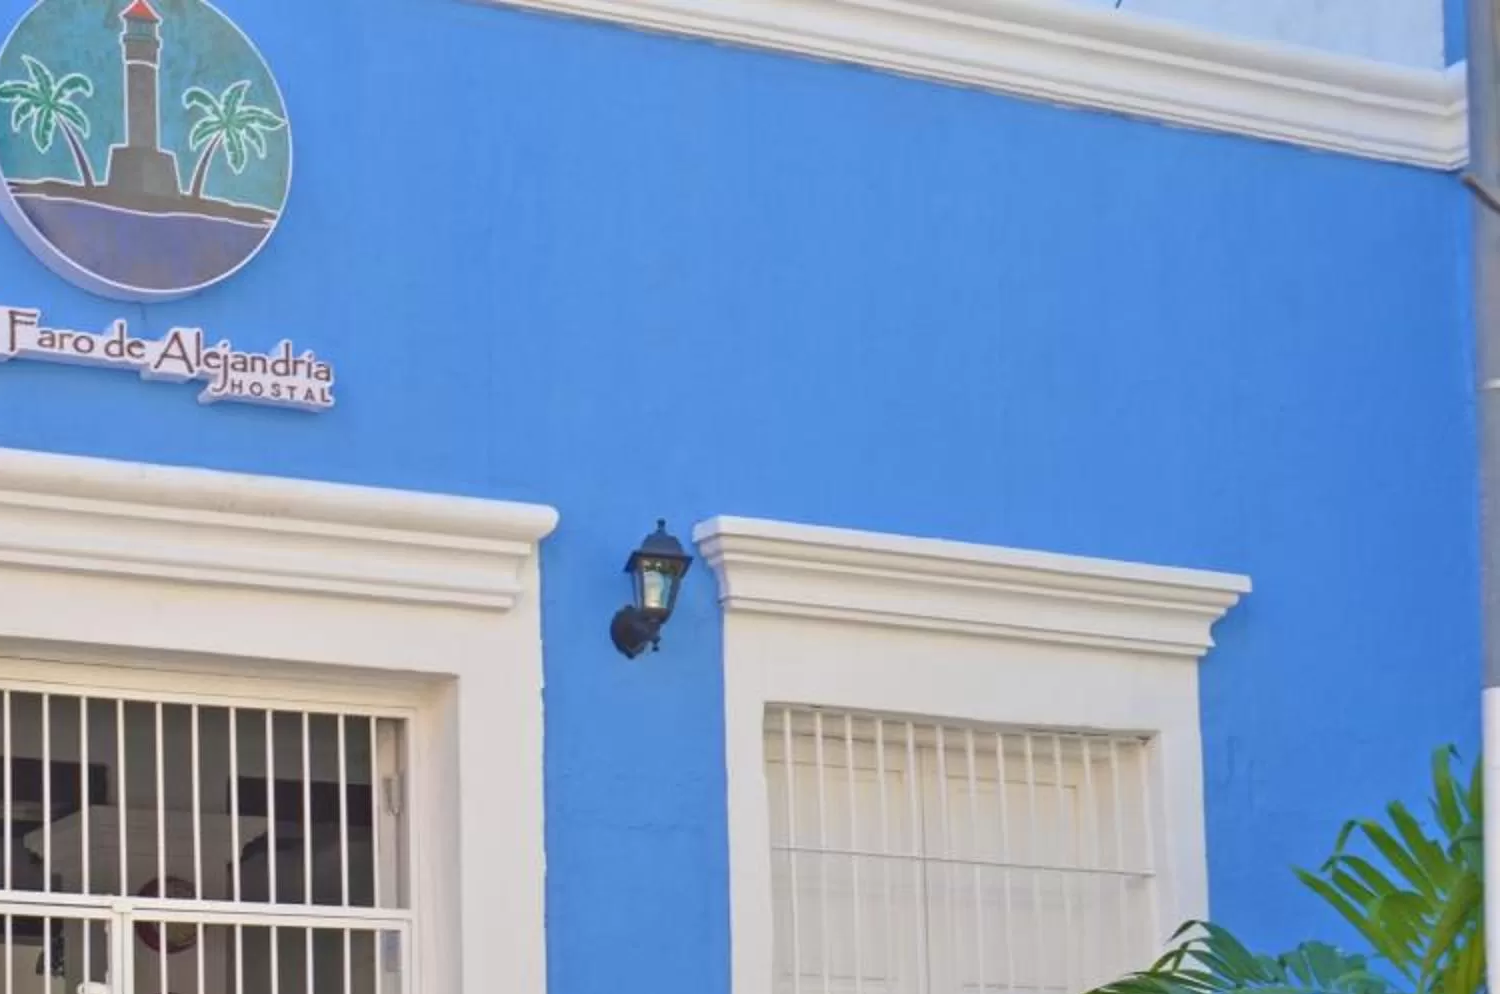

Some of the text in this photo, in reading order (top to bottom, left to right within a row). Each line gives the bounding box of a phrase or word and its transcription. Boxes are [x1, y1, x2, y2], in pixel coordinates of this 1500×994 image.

[8, 309, 95, 354] Faro
[104, 322, 146, 359] de
[230, 379, 331, 403] HOSTAL
